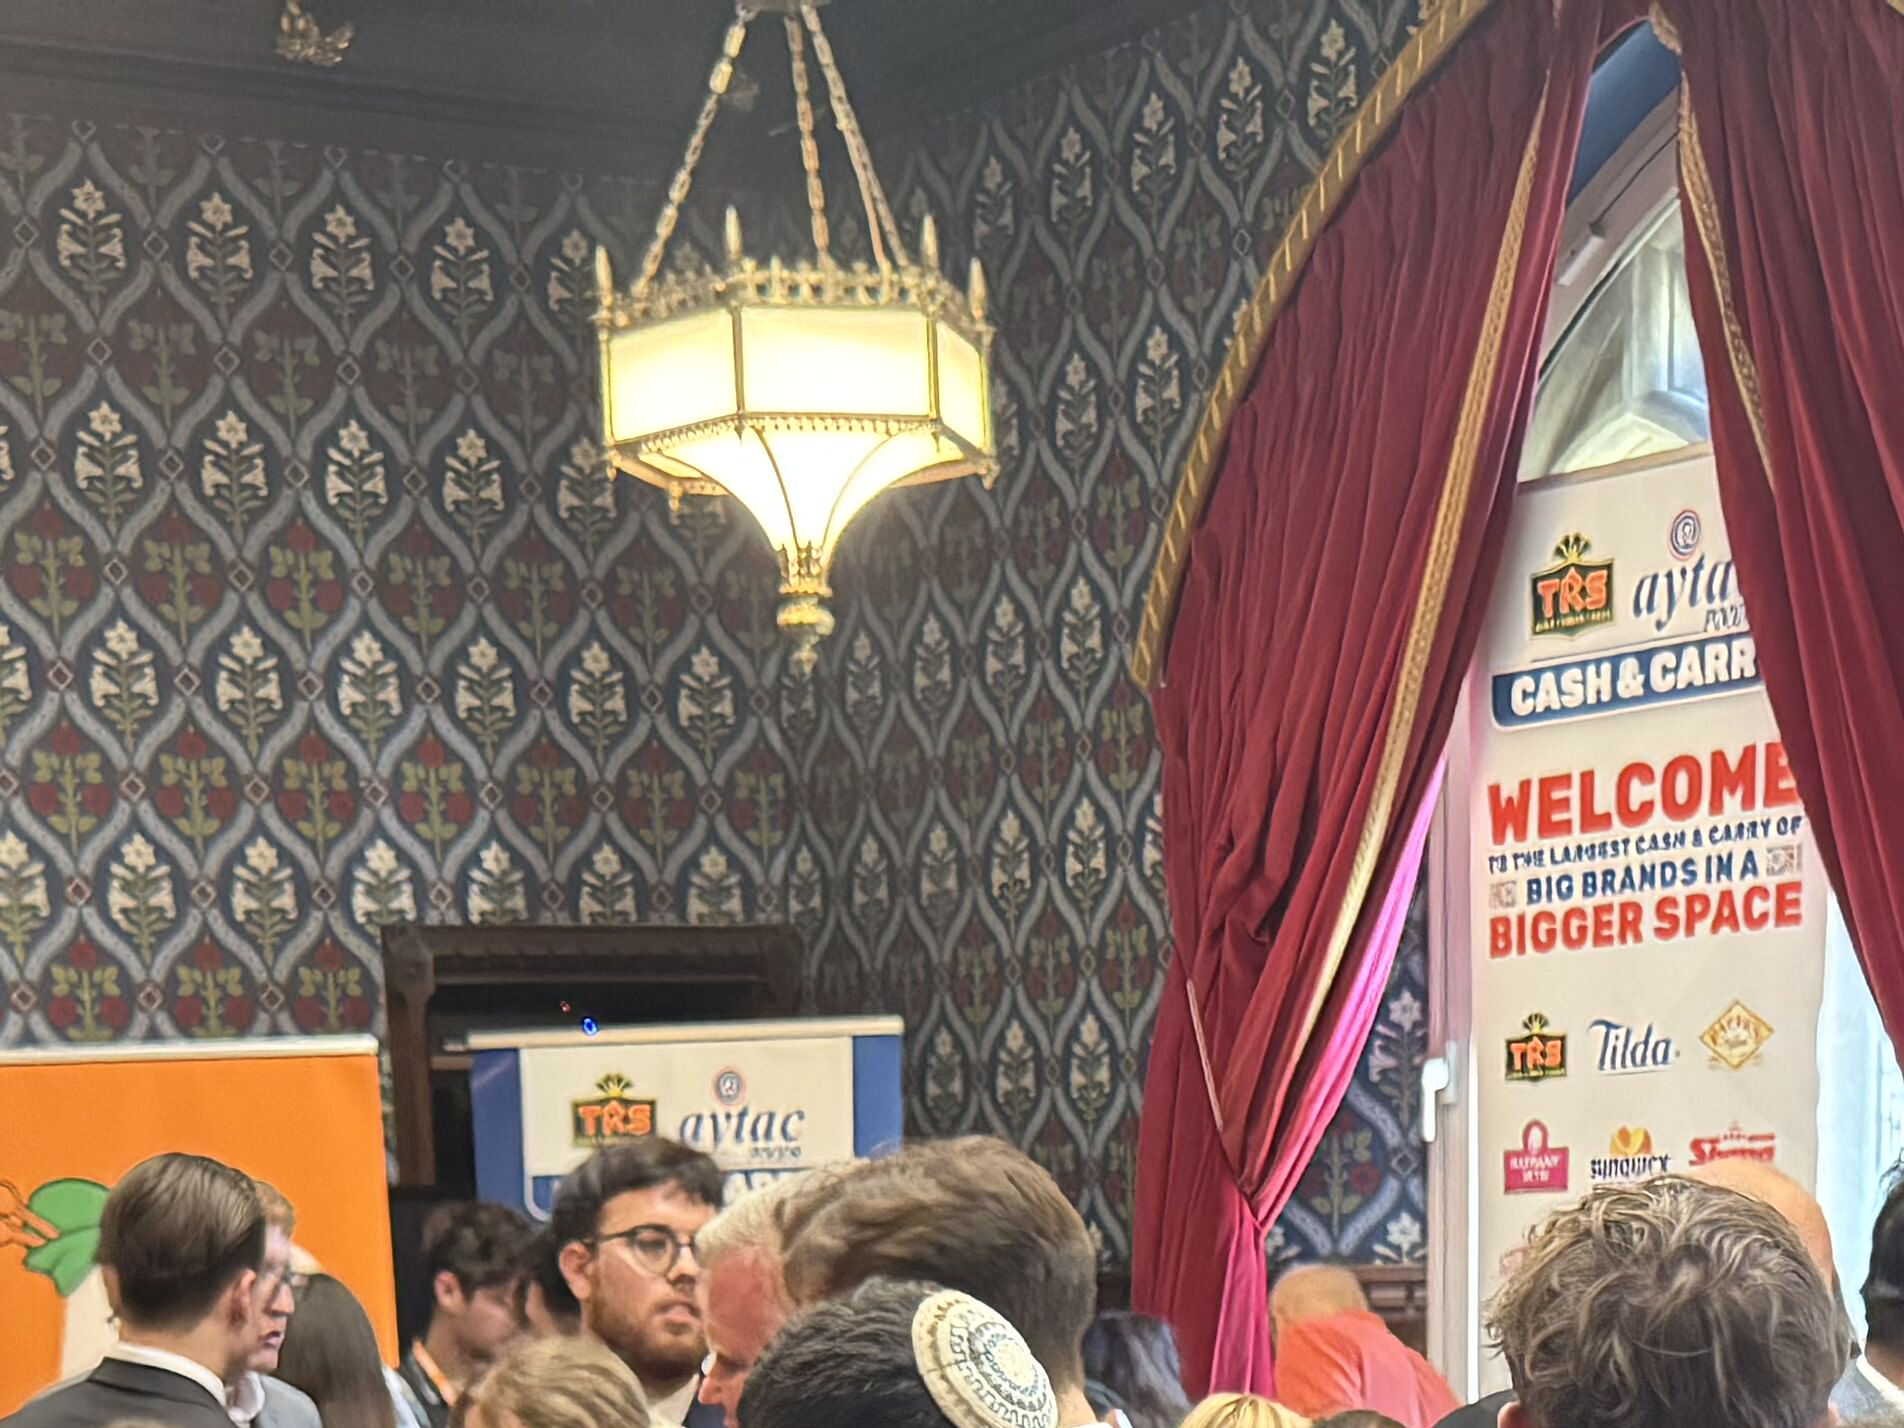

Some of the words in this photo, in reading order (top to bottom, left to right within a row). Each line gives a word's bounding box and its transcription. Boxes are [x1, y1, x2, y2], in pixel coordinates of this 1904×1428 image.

[1537, 567, 1608, 619] TRS
[1632, 552, 1733, 632] ayta
[1511, 660, 1613, 717] CASH
[1617, 656, 1645, 699] &
[1649, 637, 1757, 694] CARR
[1487, 741, 1803, 846] WELCOME
[1550, 837, 1630, 866] LARGEST
[1635, 829, 1686, 856] CASH
[1708, 819, 1772, 845] CARRY
[1776, 814, 1804, 837] OF
[1526, 873, 1575, 906] BIG
[1582, 858, 1698, 900] BRANDS
[1704, 850, 1734, 885] IN
[1739, 850, 1759, 881] A
[1489, 900, 1644, 960] BIGGER
[1652, 881, 1803, 942] SPACE
[1509, 1036, 1563, 1073] TRS
[1586, 1018, 1674, 1073] Tilda
[578, 1101, 653, 1137] TRS
[680, 1105, 806, 1149] aytac
